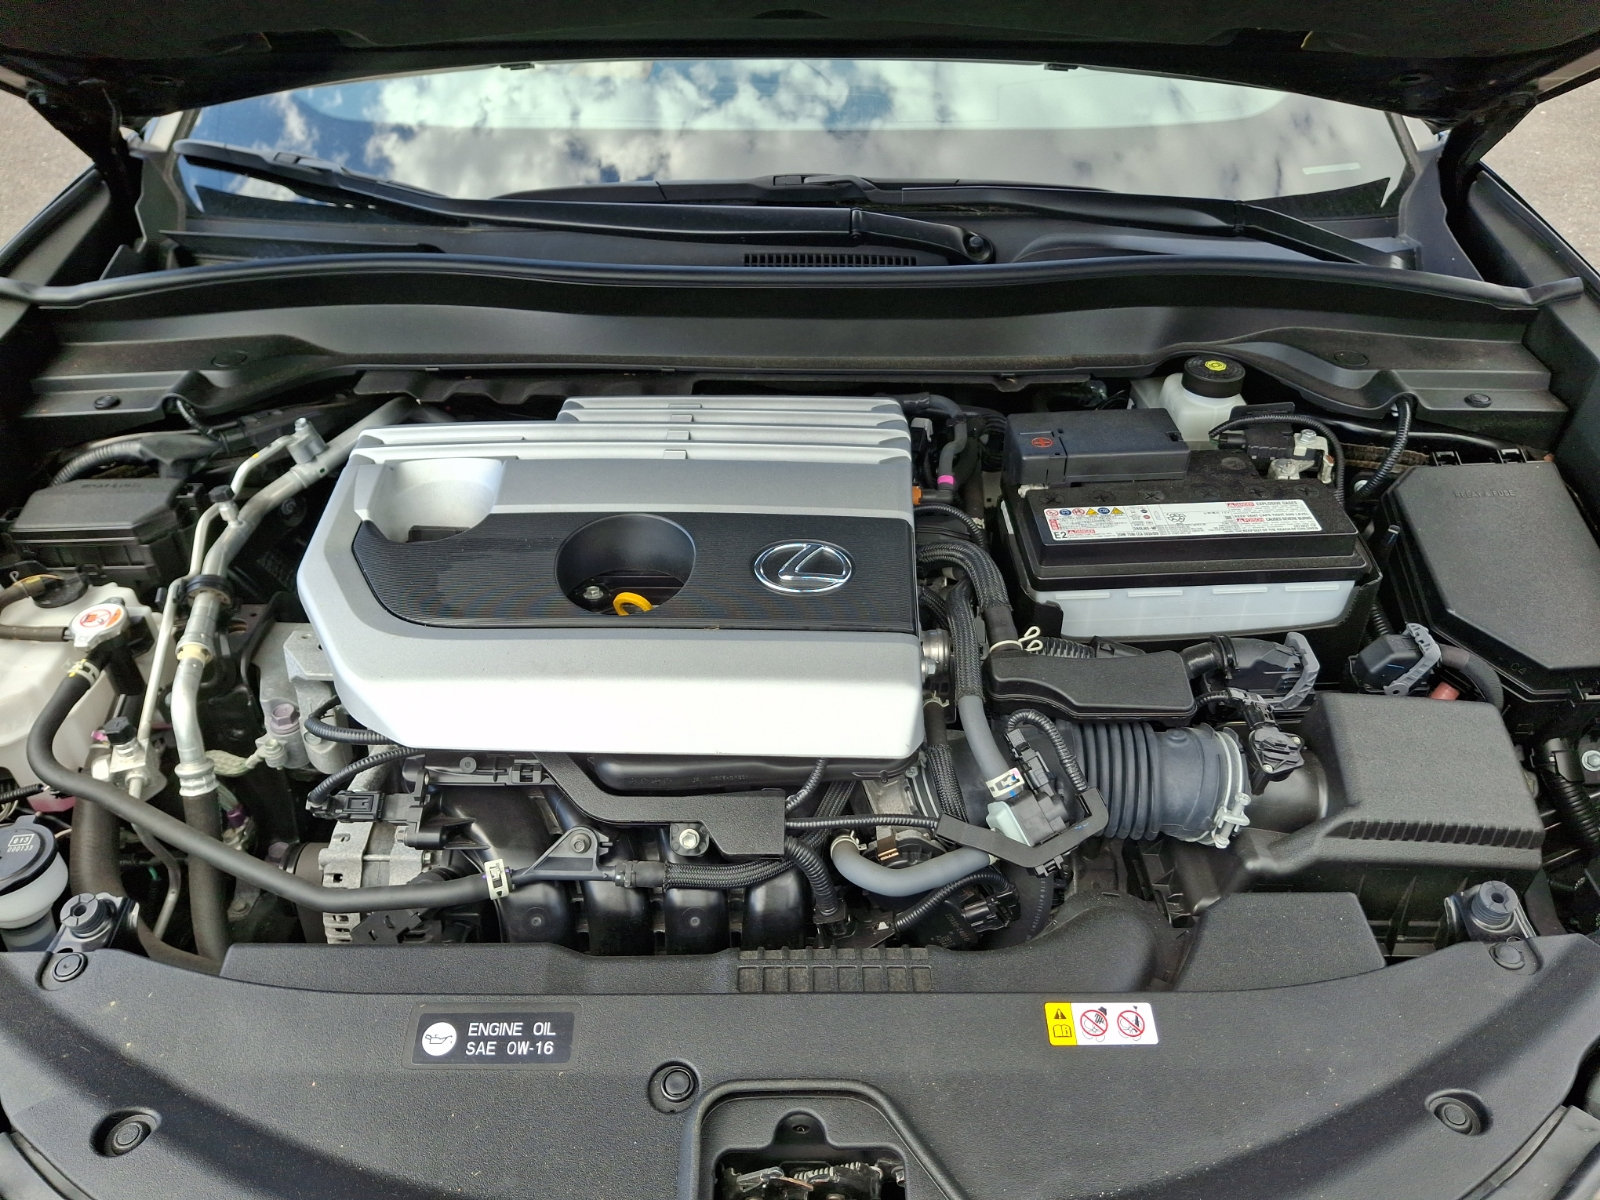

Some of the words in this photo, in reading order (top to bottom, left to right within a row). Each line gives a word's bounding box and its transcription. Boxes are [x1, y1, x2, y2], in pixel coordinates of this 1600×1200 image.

[1054, 531, 1068, 539] E2
[467, 1022, 524, 1037] ENGINE
[532, 1021, 556, 1036] OIL
[465, 1041, 496, 1056] SAE
[506, 1040, 555, 1055] 0W-16
